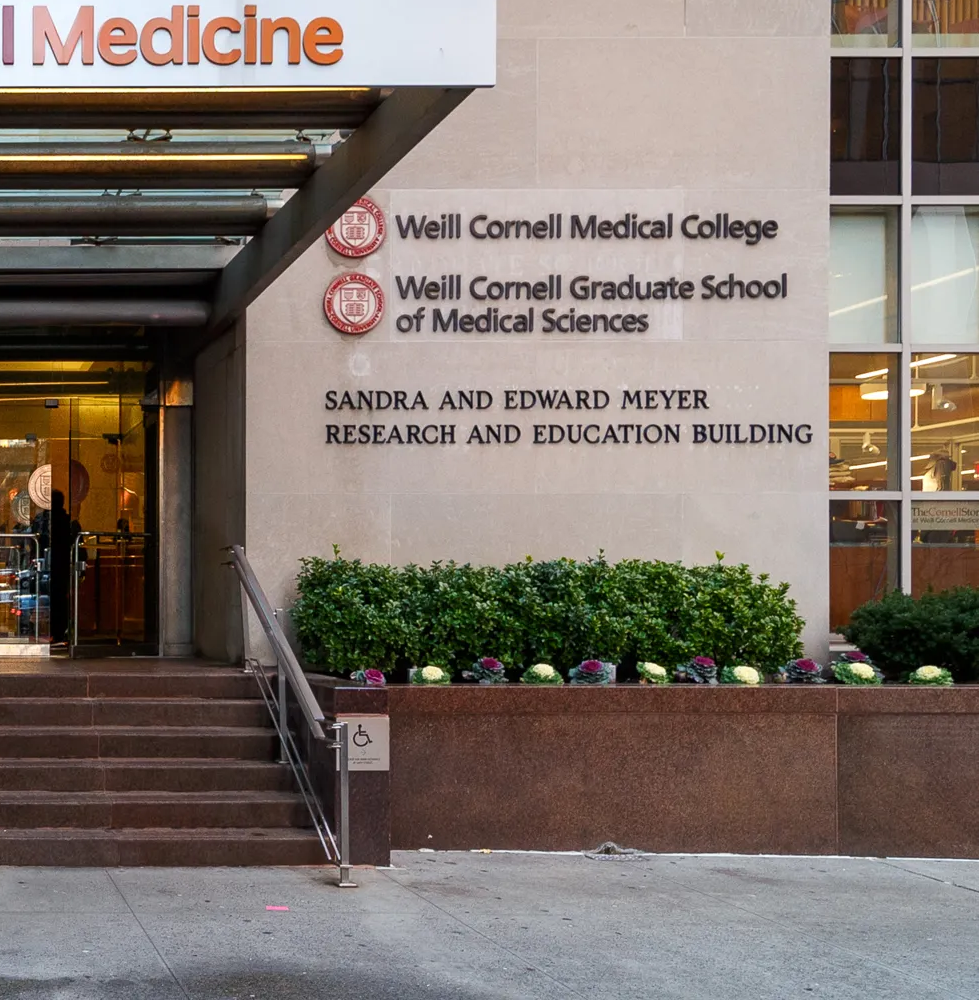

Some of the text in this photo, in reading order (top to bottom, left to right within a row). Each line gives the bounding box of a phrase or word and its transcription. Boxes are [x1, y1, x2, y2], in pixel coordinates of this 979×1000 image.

[32, 4, 345, 67] Medicine
[395, 213, 780, 247] Weill Cornell Medical College
[395, 273, 789, 302] Weill Cornell Graduate School
[396, 307, 651, 335] of Medical Sciences
[325, 390, 711, 413] SANDRA AND EDWARD MEYER
[326, 424, 814, 447] RESEARCH AND EDUCATION BUILDING
